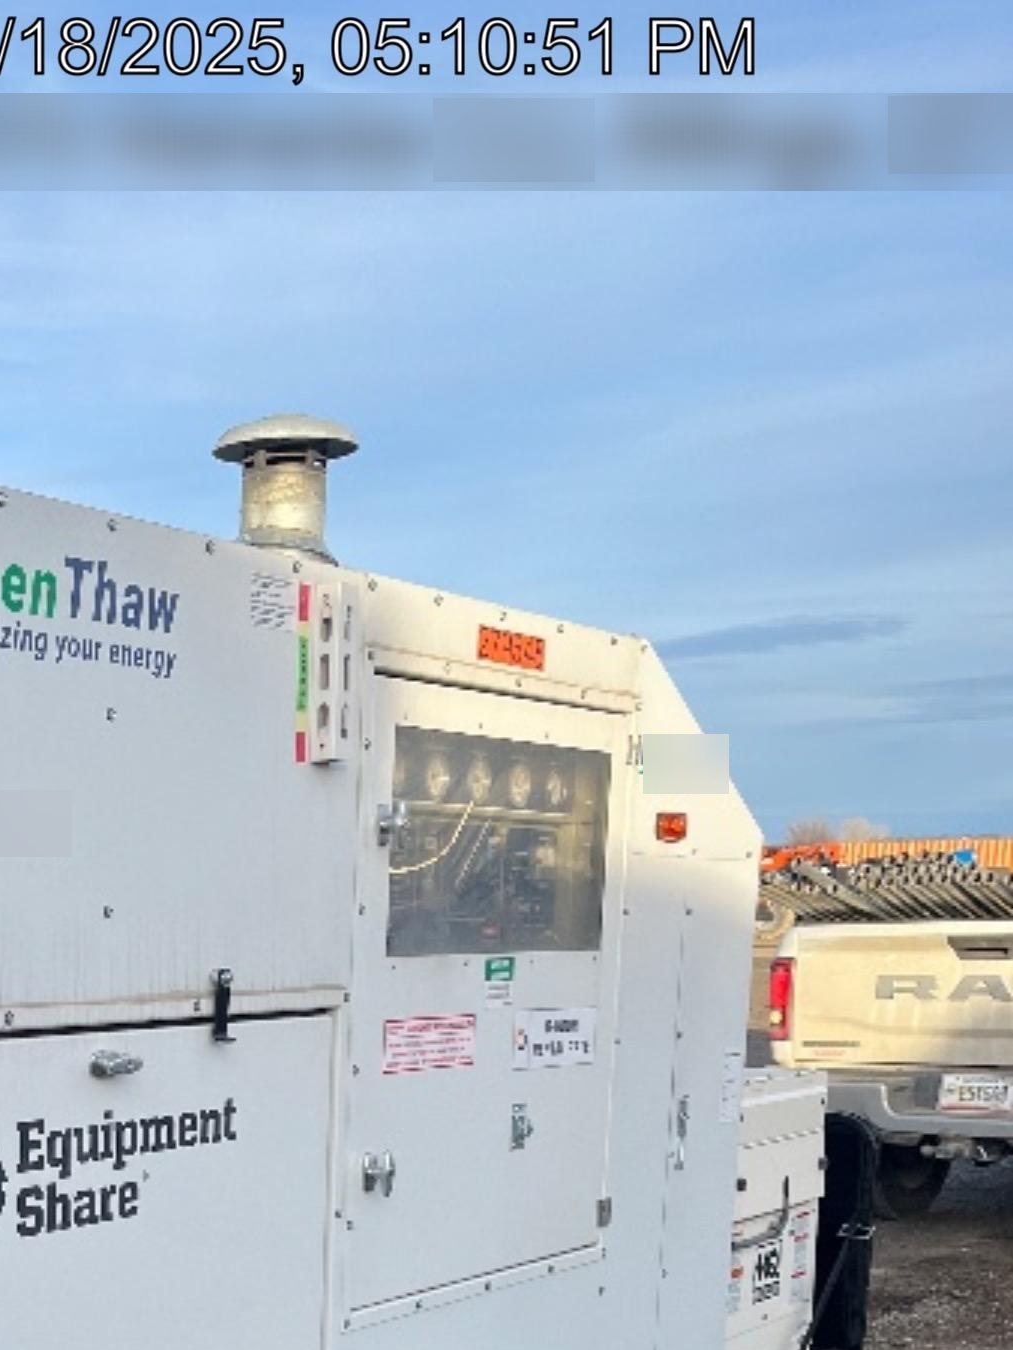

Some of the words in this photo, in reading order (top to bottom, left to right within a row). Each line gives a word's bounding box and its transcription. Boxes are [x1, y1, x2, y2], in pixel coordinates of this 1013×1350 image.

[55, 634, 102, 664] your
[109, 643, 178, 679] energy
[16, 1097, 237, 1180] Equipment
[16, 1181, 139, 1237] Share
